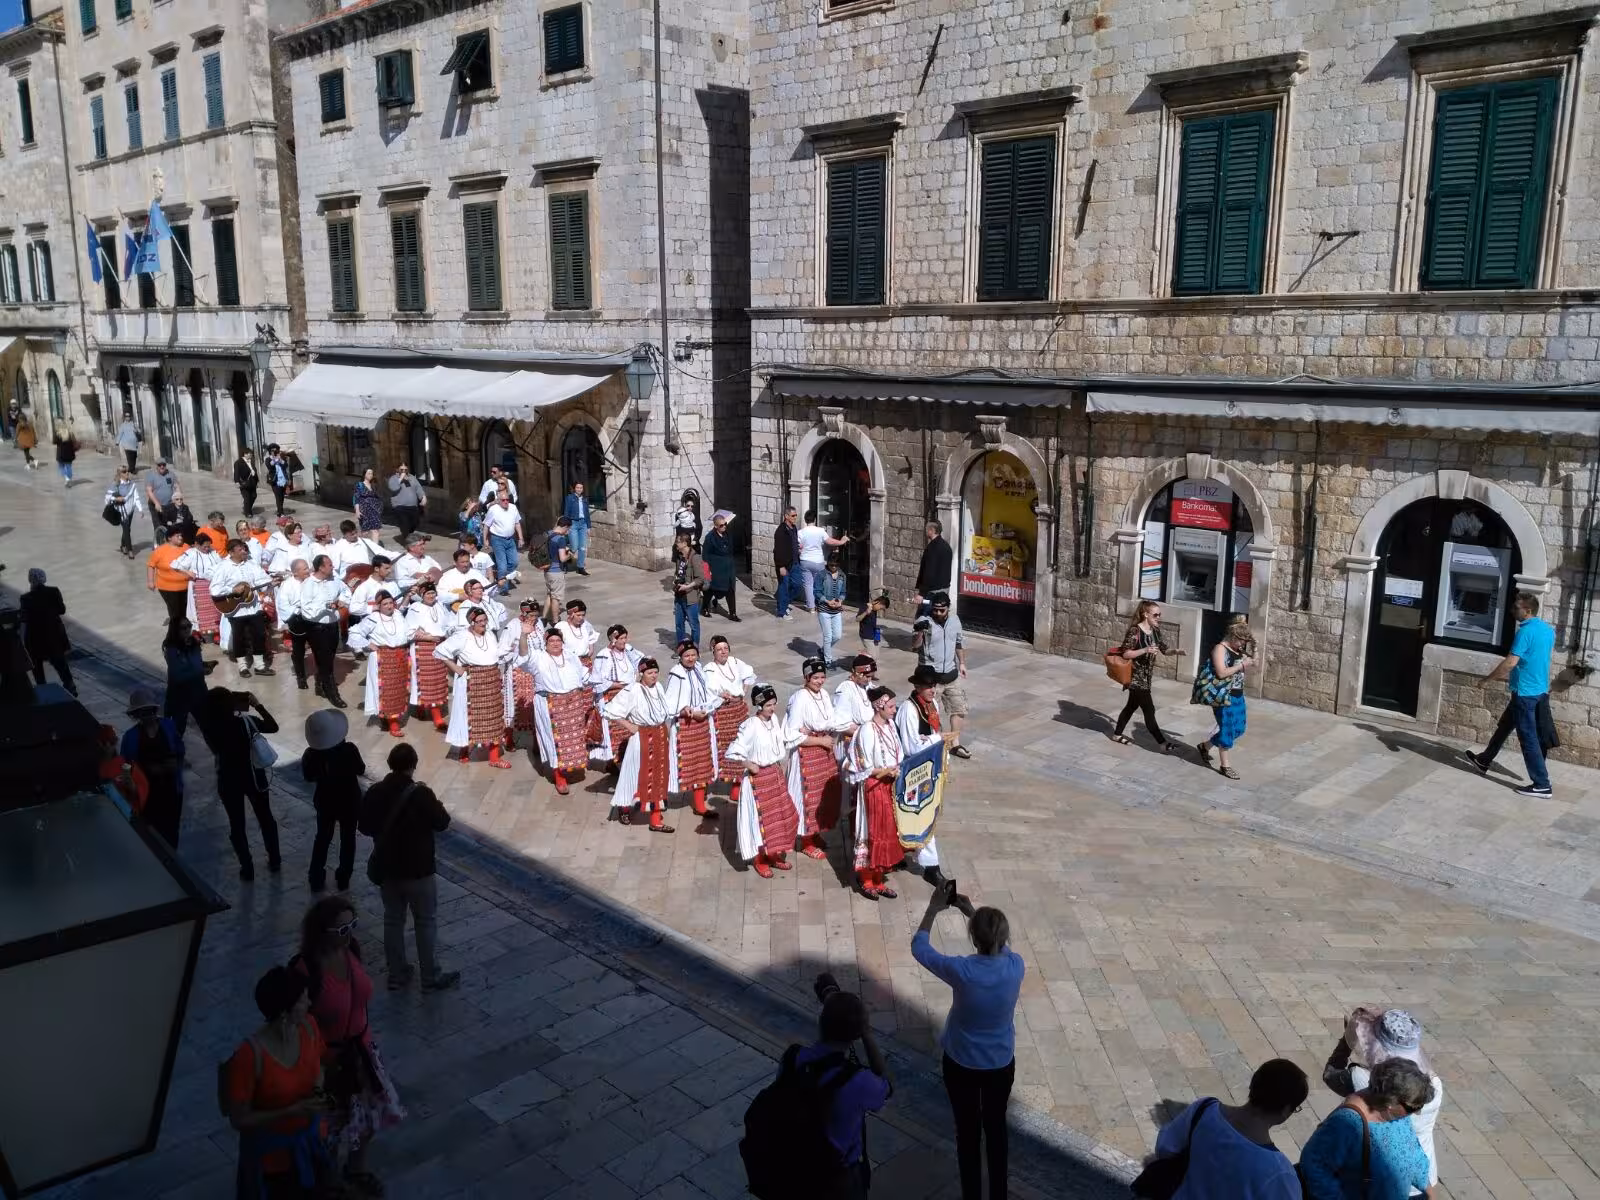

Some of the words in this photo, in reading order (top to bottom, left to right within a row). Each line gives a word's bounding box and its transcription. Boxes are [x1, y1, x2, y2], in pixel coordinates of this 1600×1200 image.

[1199, 485, 1219, 496] PBZ
[1182, 501, 1218, 512] Bankomat
[963, 575, 1020, 600] bonbonnière
